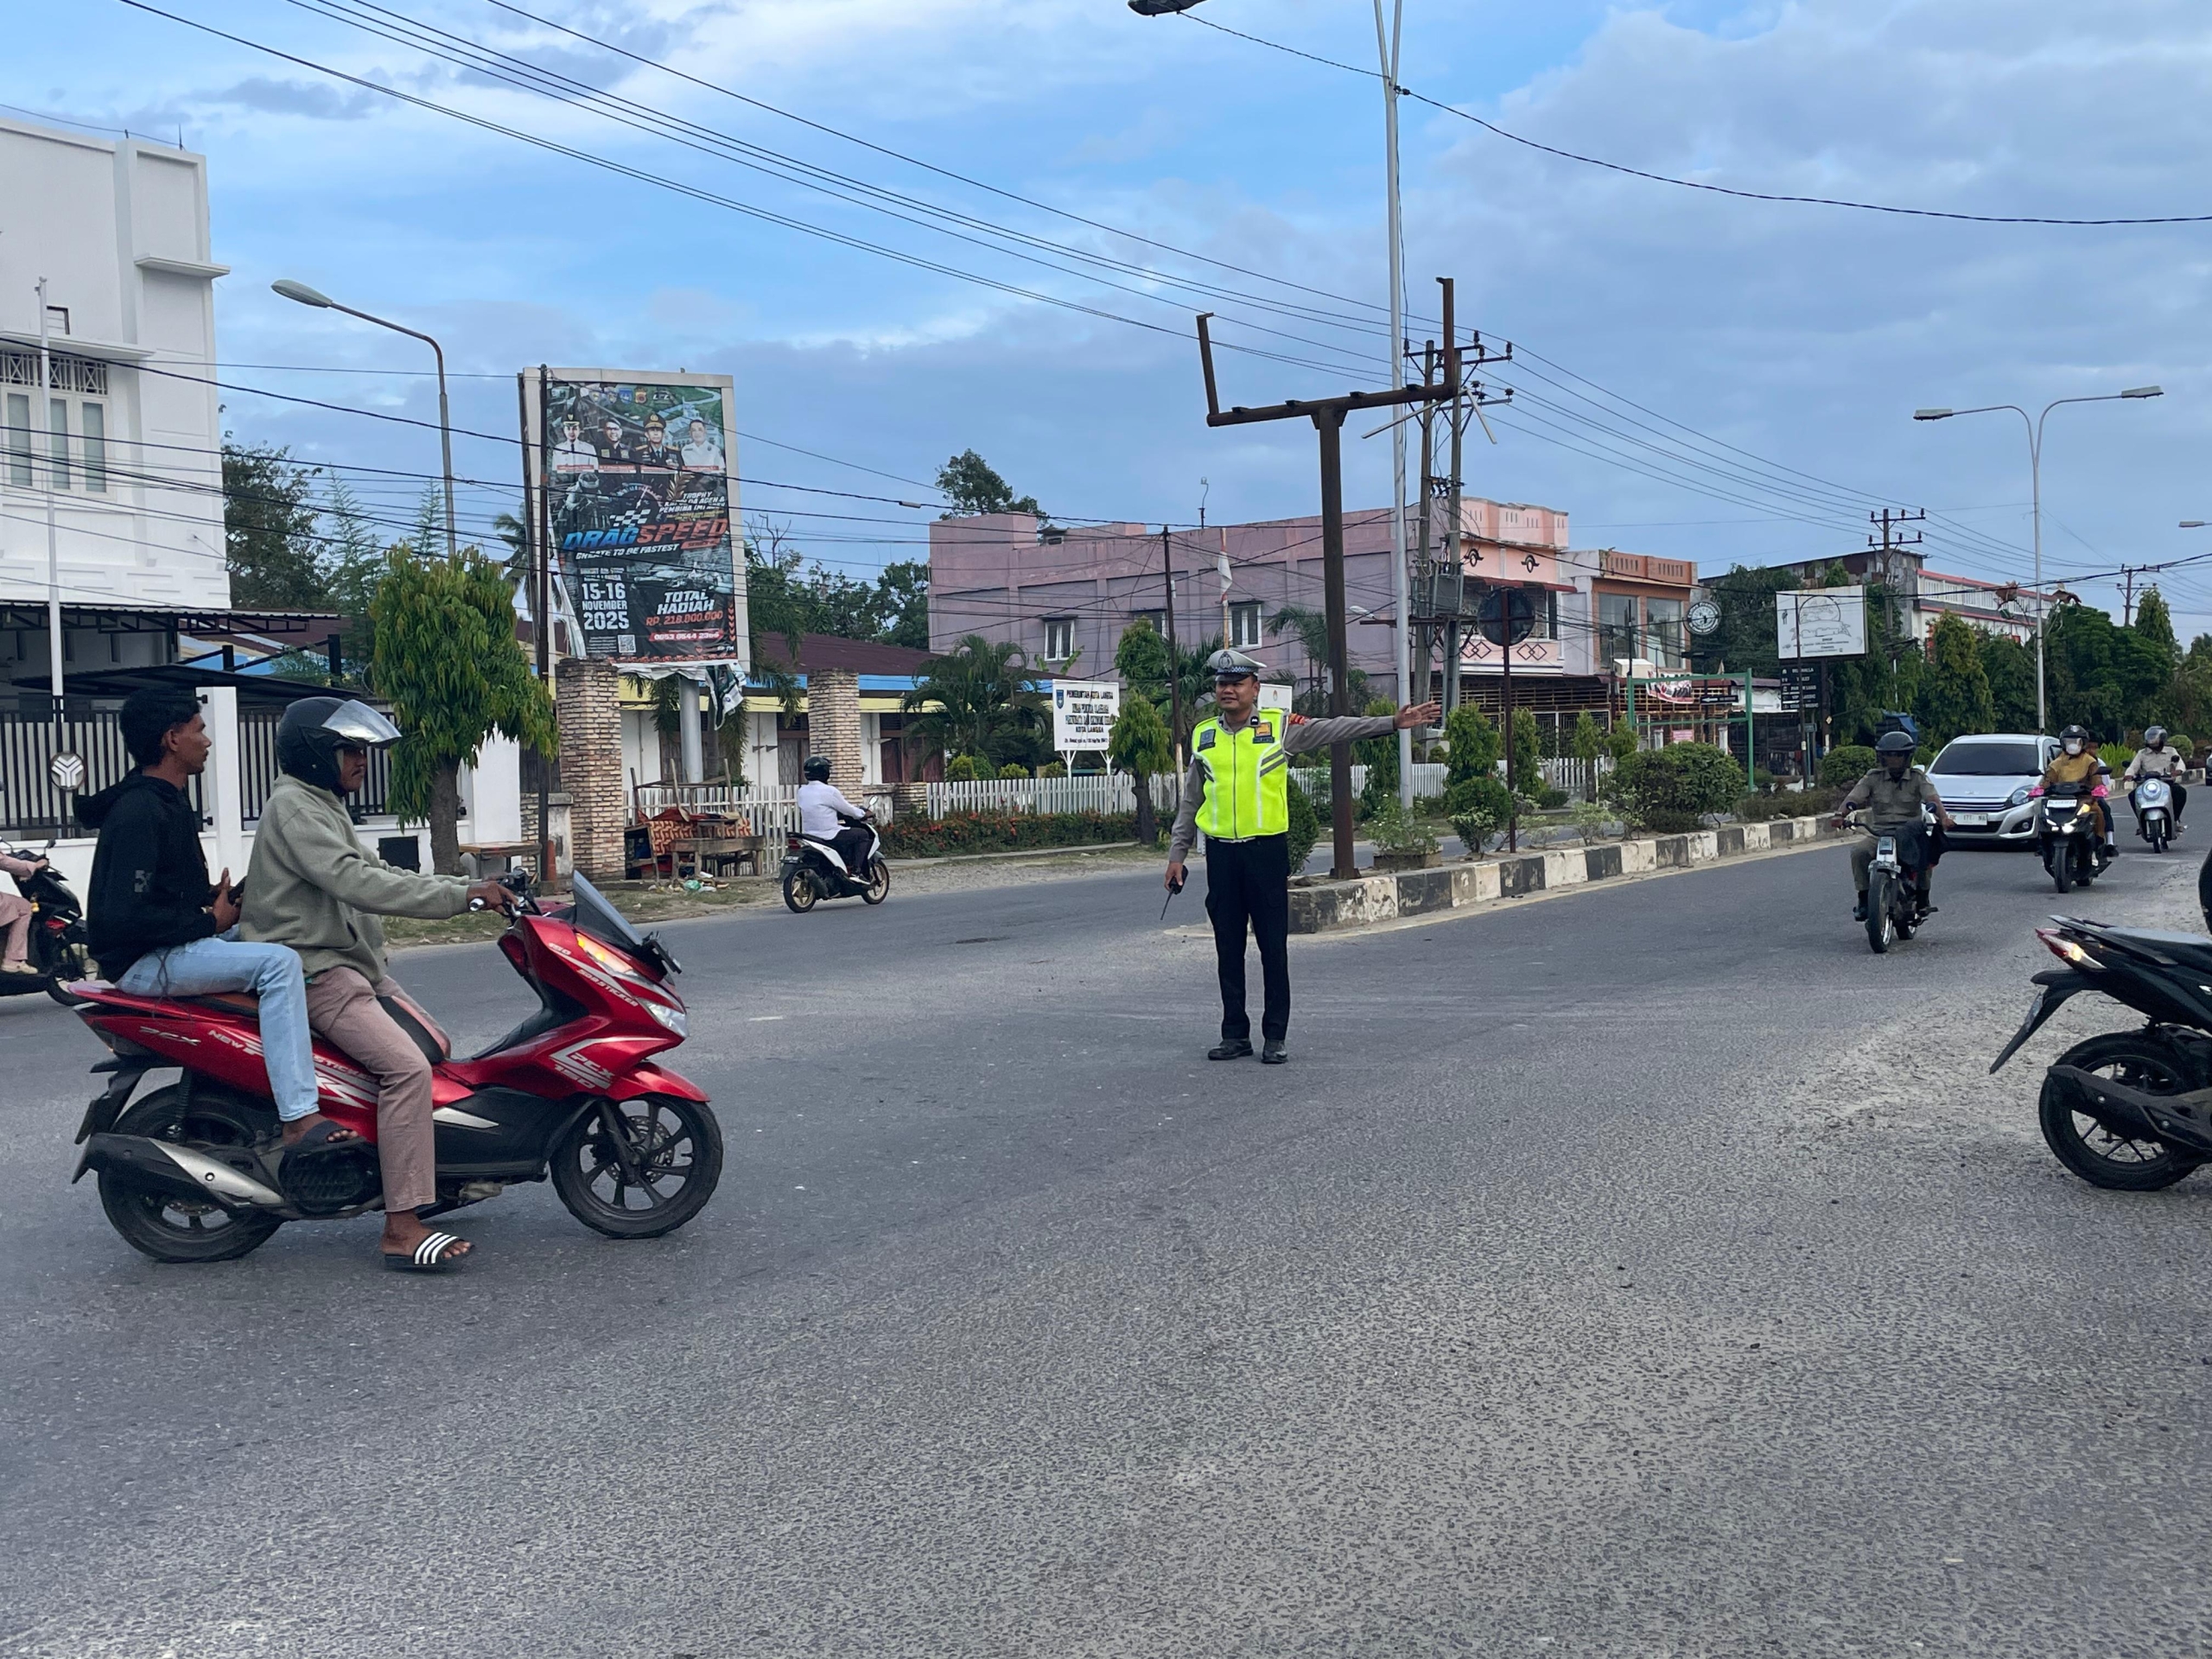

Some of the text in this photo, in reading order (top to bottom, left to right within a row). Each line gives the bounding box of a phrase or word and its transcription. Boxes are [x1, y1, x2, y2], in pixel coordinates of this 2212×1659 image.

[683, 491, 713, 499] TROPHY
[658, 505, 692, 513] PEMBINA
[626, 546, 639, 555] BE
[639, 543, 680, 554] FASTEST
[582, 582, 626, 600] 15-16
[664, 590, 709, 603] TOTAL
[582, 601, 628, 611] NOVEMBER
[657, 599, 715, 615] HADIAH
[583, 611, 630, 630] 2025
[138, 1026, 201, 1046] PCX
[570, 1052, 615, 1080] PCX
